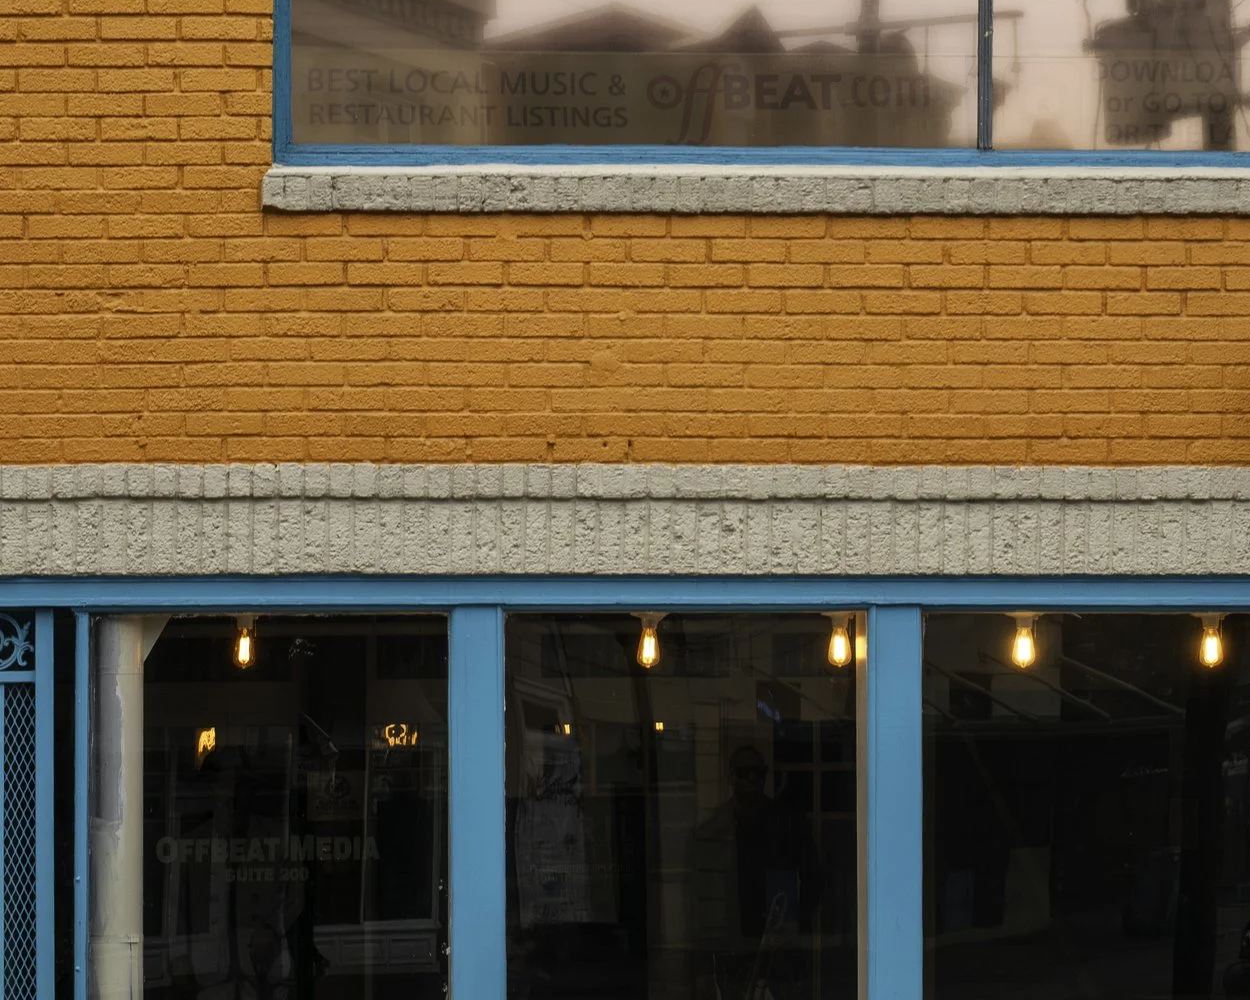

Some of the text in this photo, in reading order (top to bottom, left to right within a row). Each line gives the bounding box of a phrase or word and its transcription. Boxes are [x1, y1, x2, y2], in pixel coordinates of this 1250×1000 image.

[307, 67, 627, 97] BEST LOCAL MUSIC &
[309, 103, 628, 129] RESTAURANT LISTINGS
[1143, 93, 1182, 113] GO
[155, 835, 381, 864] OFFBEAT MEDIA
[225, 867, 310, 883] SUITE 200
